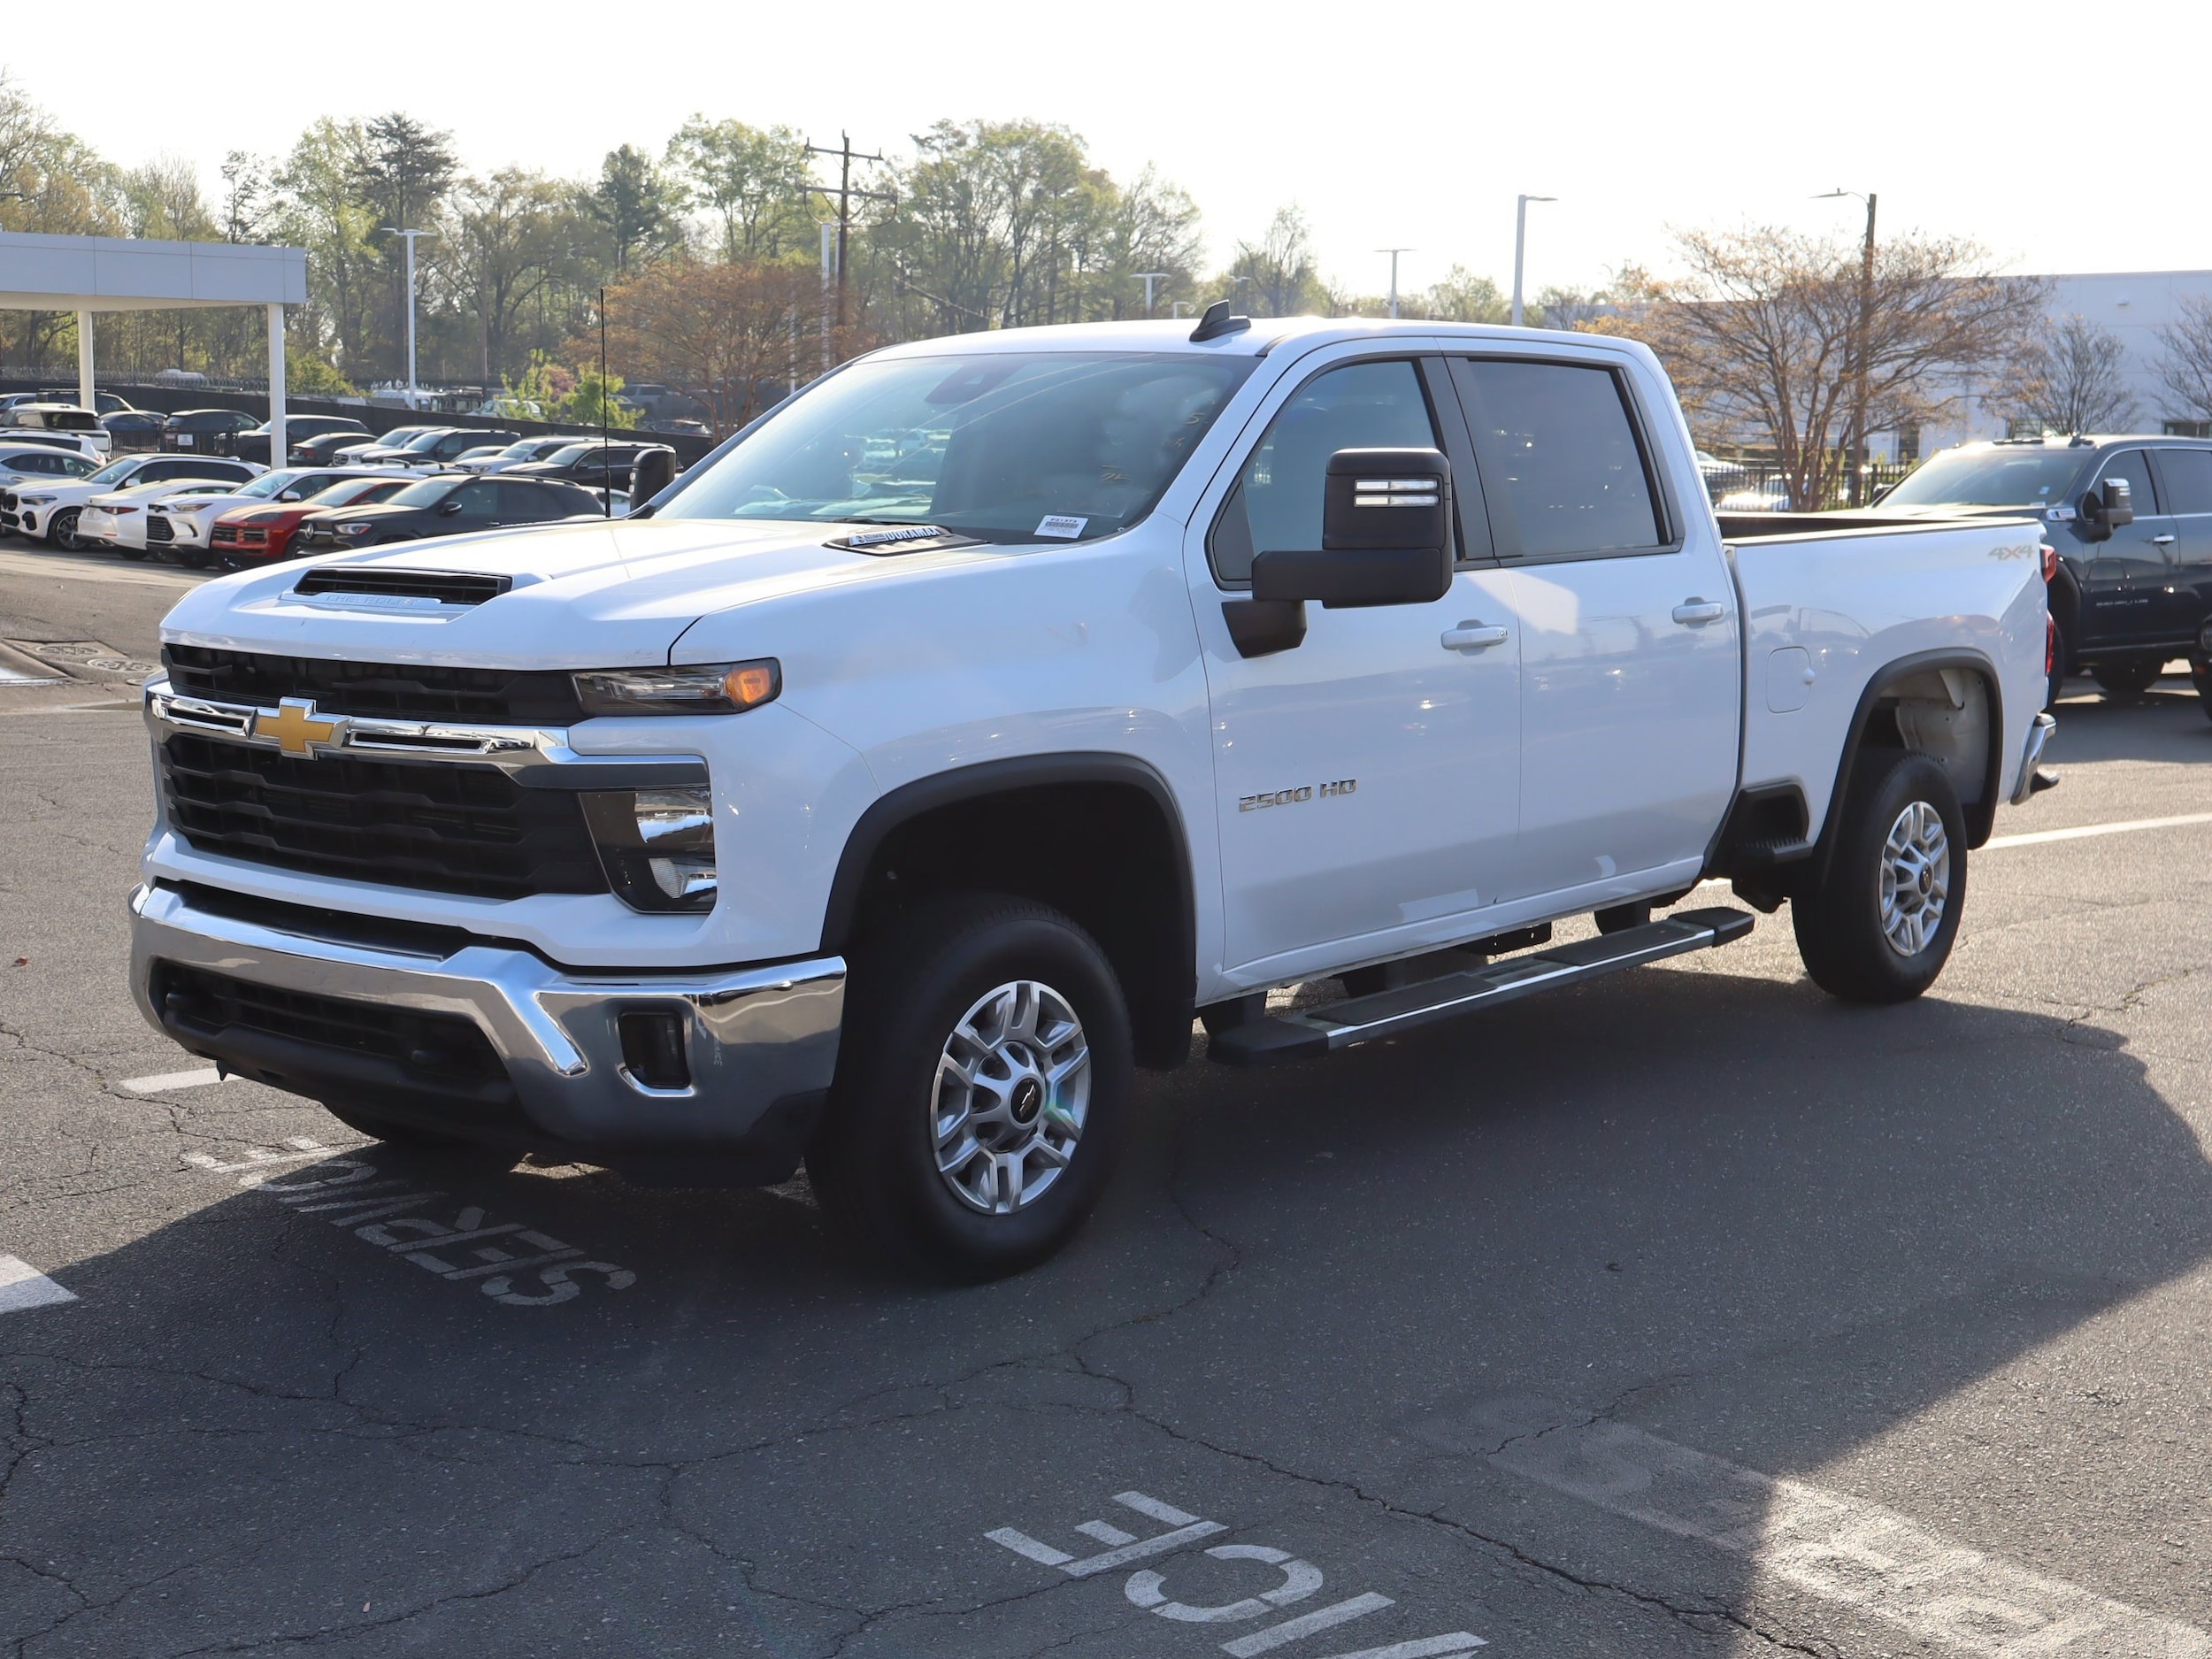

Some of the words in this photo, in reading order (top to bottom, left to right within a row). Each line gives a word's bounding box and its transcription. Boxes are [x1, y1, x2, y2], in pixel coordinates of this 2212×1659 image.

[1239, 786, 1312, 812] 2500
[1319, 779, 1357, 798] HD
[180, 1134, 636, 1305] SERVICE
